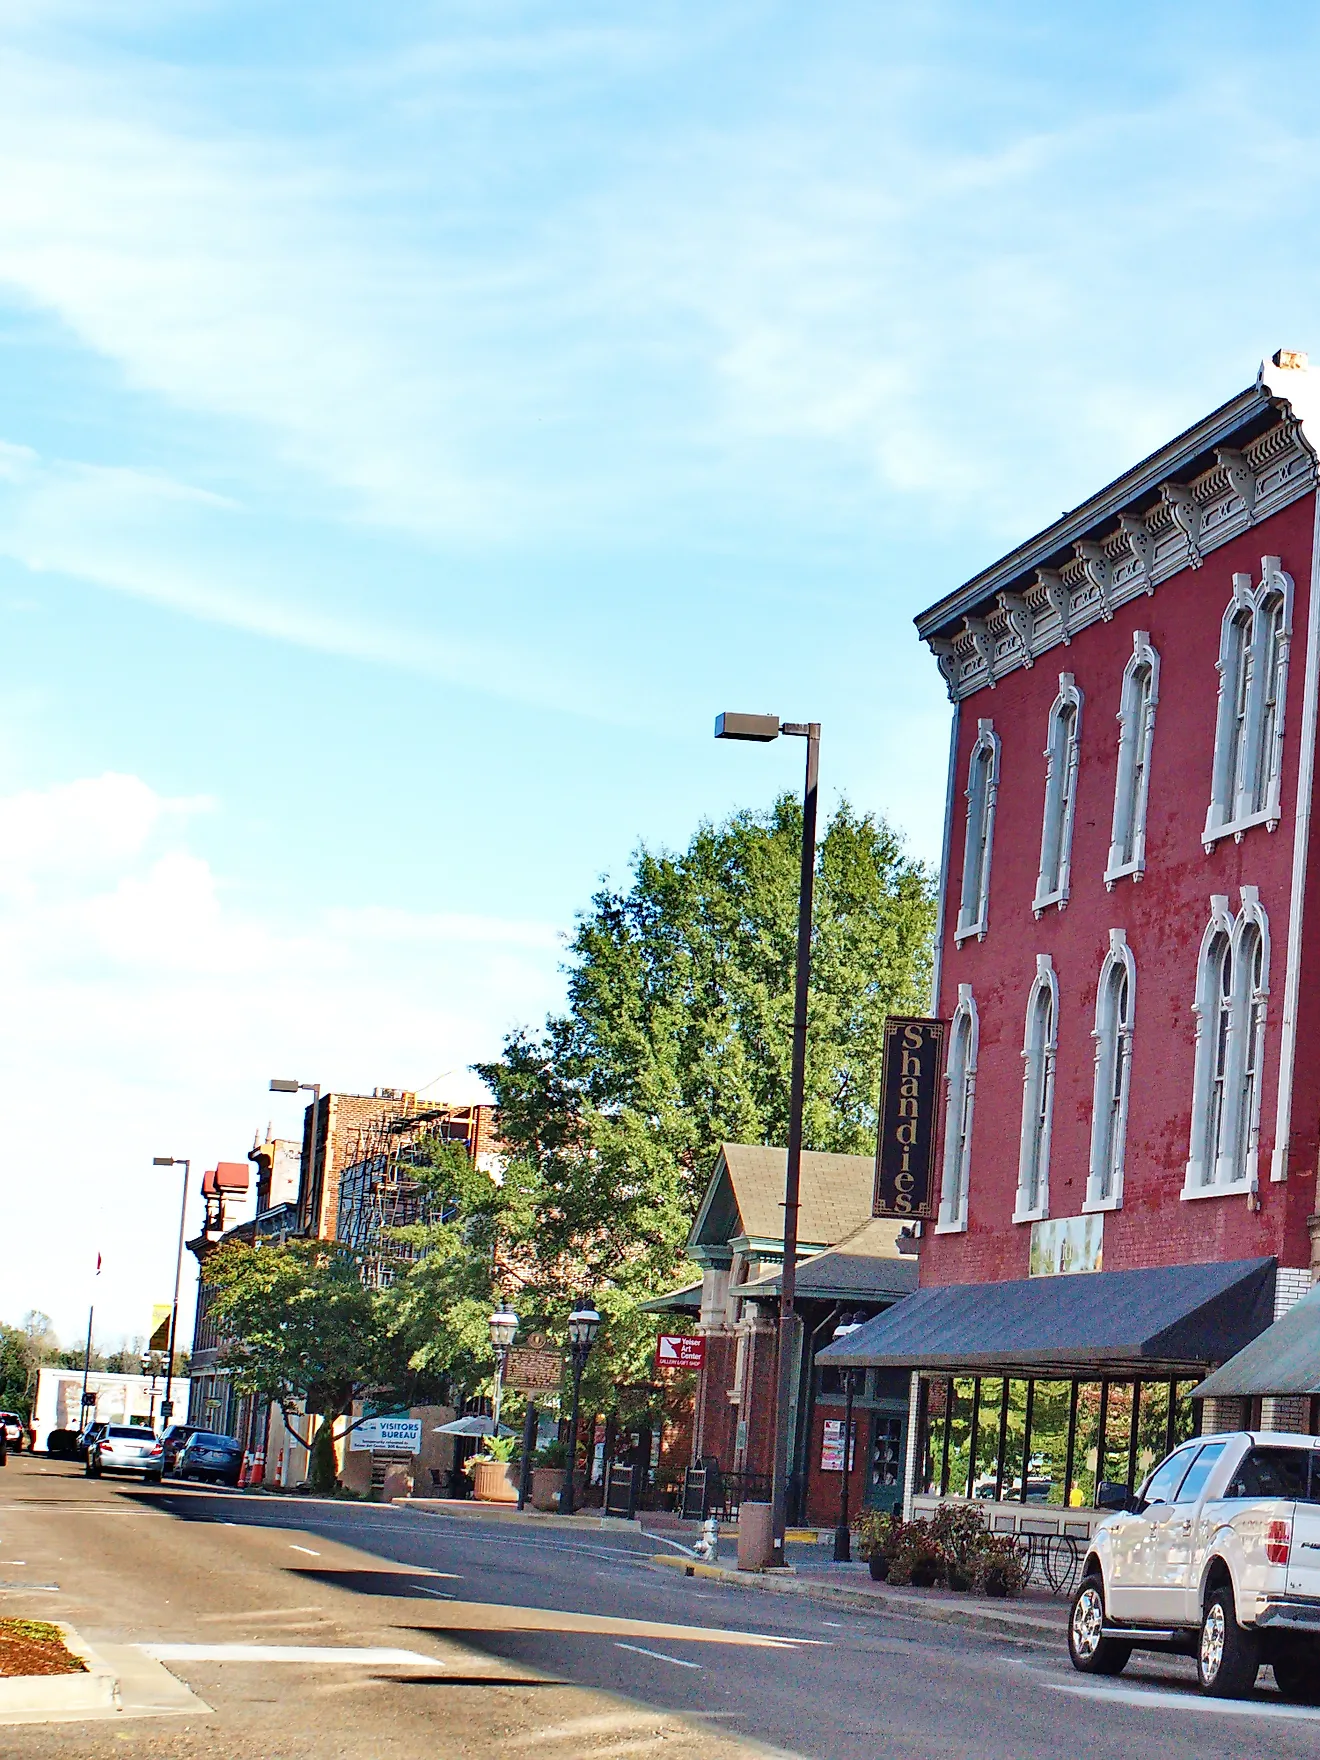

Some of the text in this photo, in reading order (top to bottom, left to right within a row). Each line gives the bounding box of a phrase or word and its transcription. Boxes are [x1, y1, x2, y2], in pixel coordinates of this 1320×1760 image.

[894, 1024, 924, 1214] Shandies
[682, 1338, 701, 1346] Yeiser
[681, 1352, 701, 1360] Center
[380, 1423, 418, 1431] VISITORS
[382, 1431, 416, 1439] BUREAU
